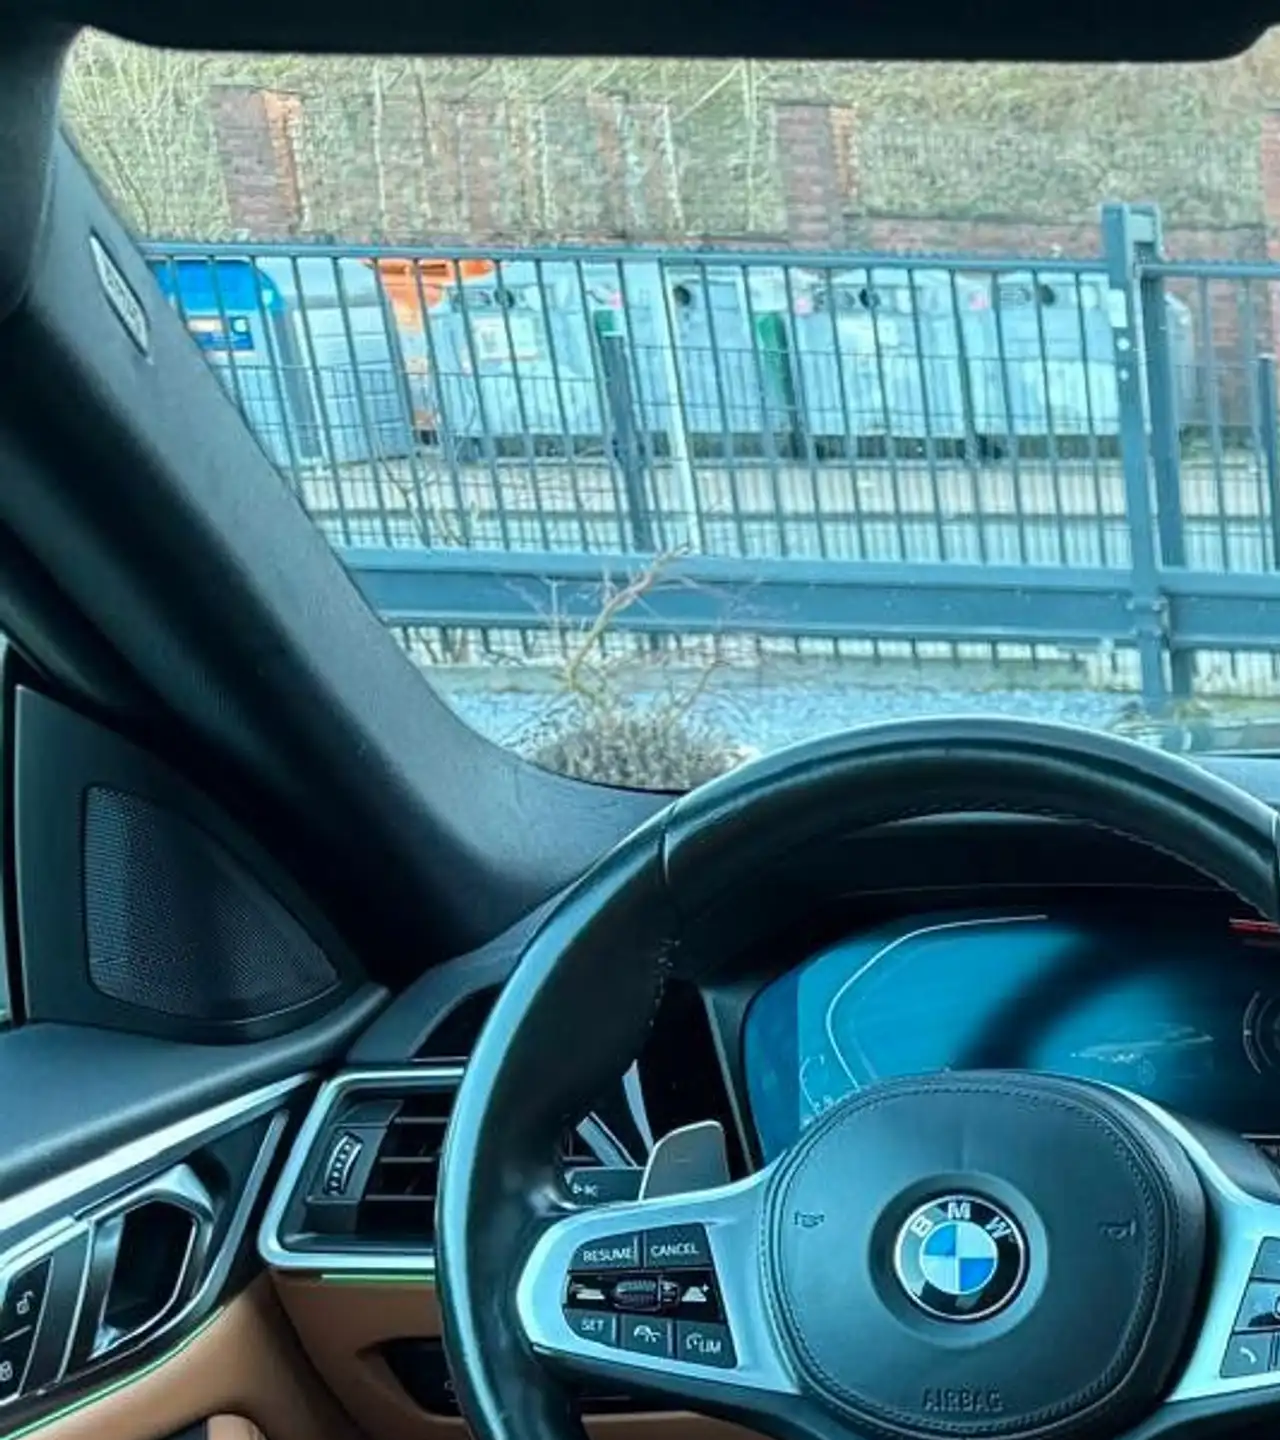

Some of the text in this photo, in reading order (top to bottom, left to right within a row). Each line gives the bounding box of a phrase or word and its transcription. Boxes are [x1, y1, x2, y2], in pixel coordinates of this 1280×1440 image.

[909, 1201, 1012, 1240] BMW
[583, 1248, 633, 1263] RESUME
[650, 1242, 699, 1258] CANCEL
[581, 1319, 605, 1332] SET
[922, 1385, 1004, 1413] AIRBAG
